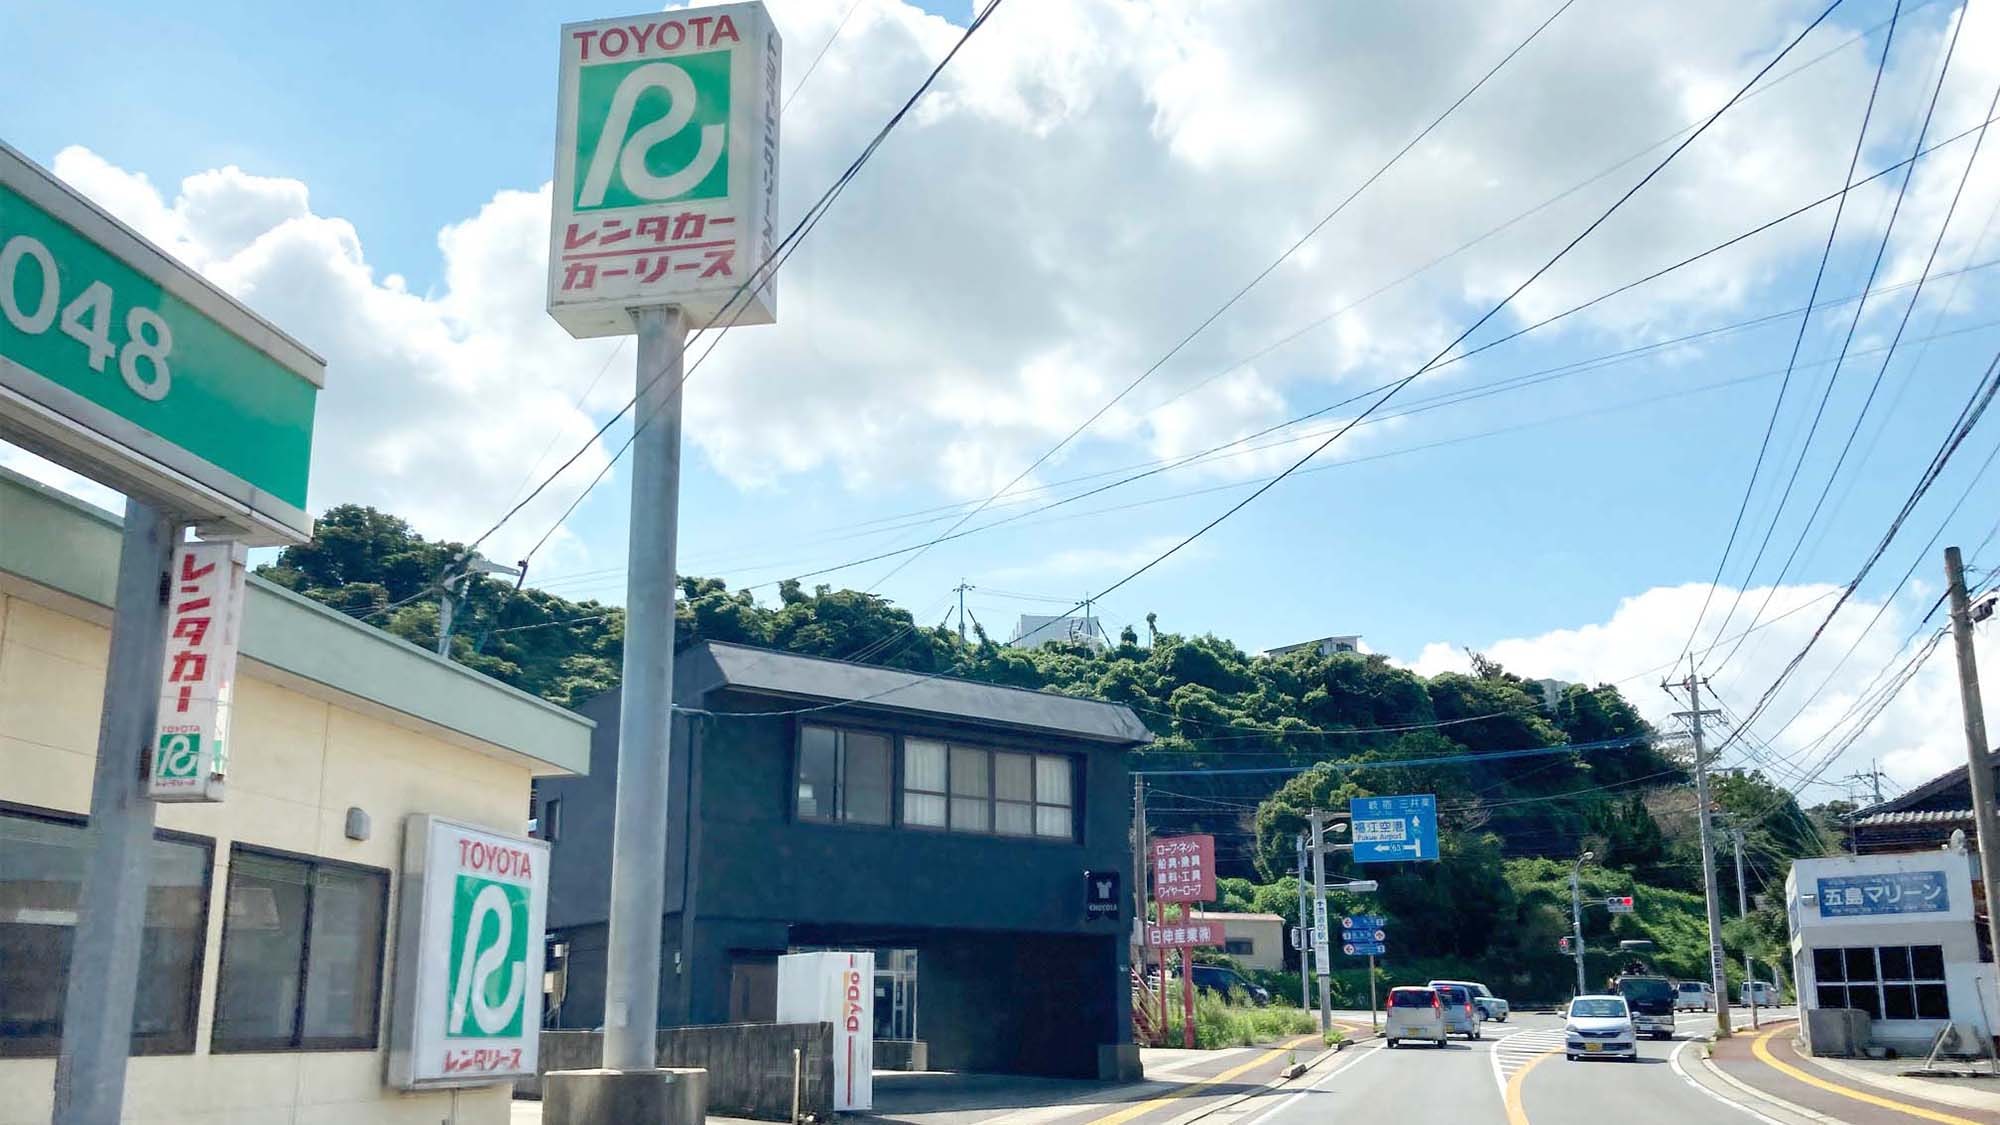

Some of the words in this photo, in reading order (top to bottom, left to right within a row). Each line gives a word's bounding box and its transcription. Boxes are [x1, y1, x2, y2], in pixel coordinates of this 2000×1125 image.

[572, 15, 740, 60] TOYOTA
[564, 212, 736, 249] レンタカー
[561, 250, 736, 290] カーリース
[0, 235, 172, 402] 048
[168, 554, 215, 712] レンタカー
[1354, 821, 1405, 833] 福江空港
[1380, 832, 1402, 841] Airport
[459, 840, 532, 880] TOYOTA
[1158, 885, 1201, 898] ワイヤーロープ
[1824, 884, 1941, 906] 五島マリーン
[847, 971, 862, 1032] DyDo
[443, 1049, 522, 1073] レンタリース
